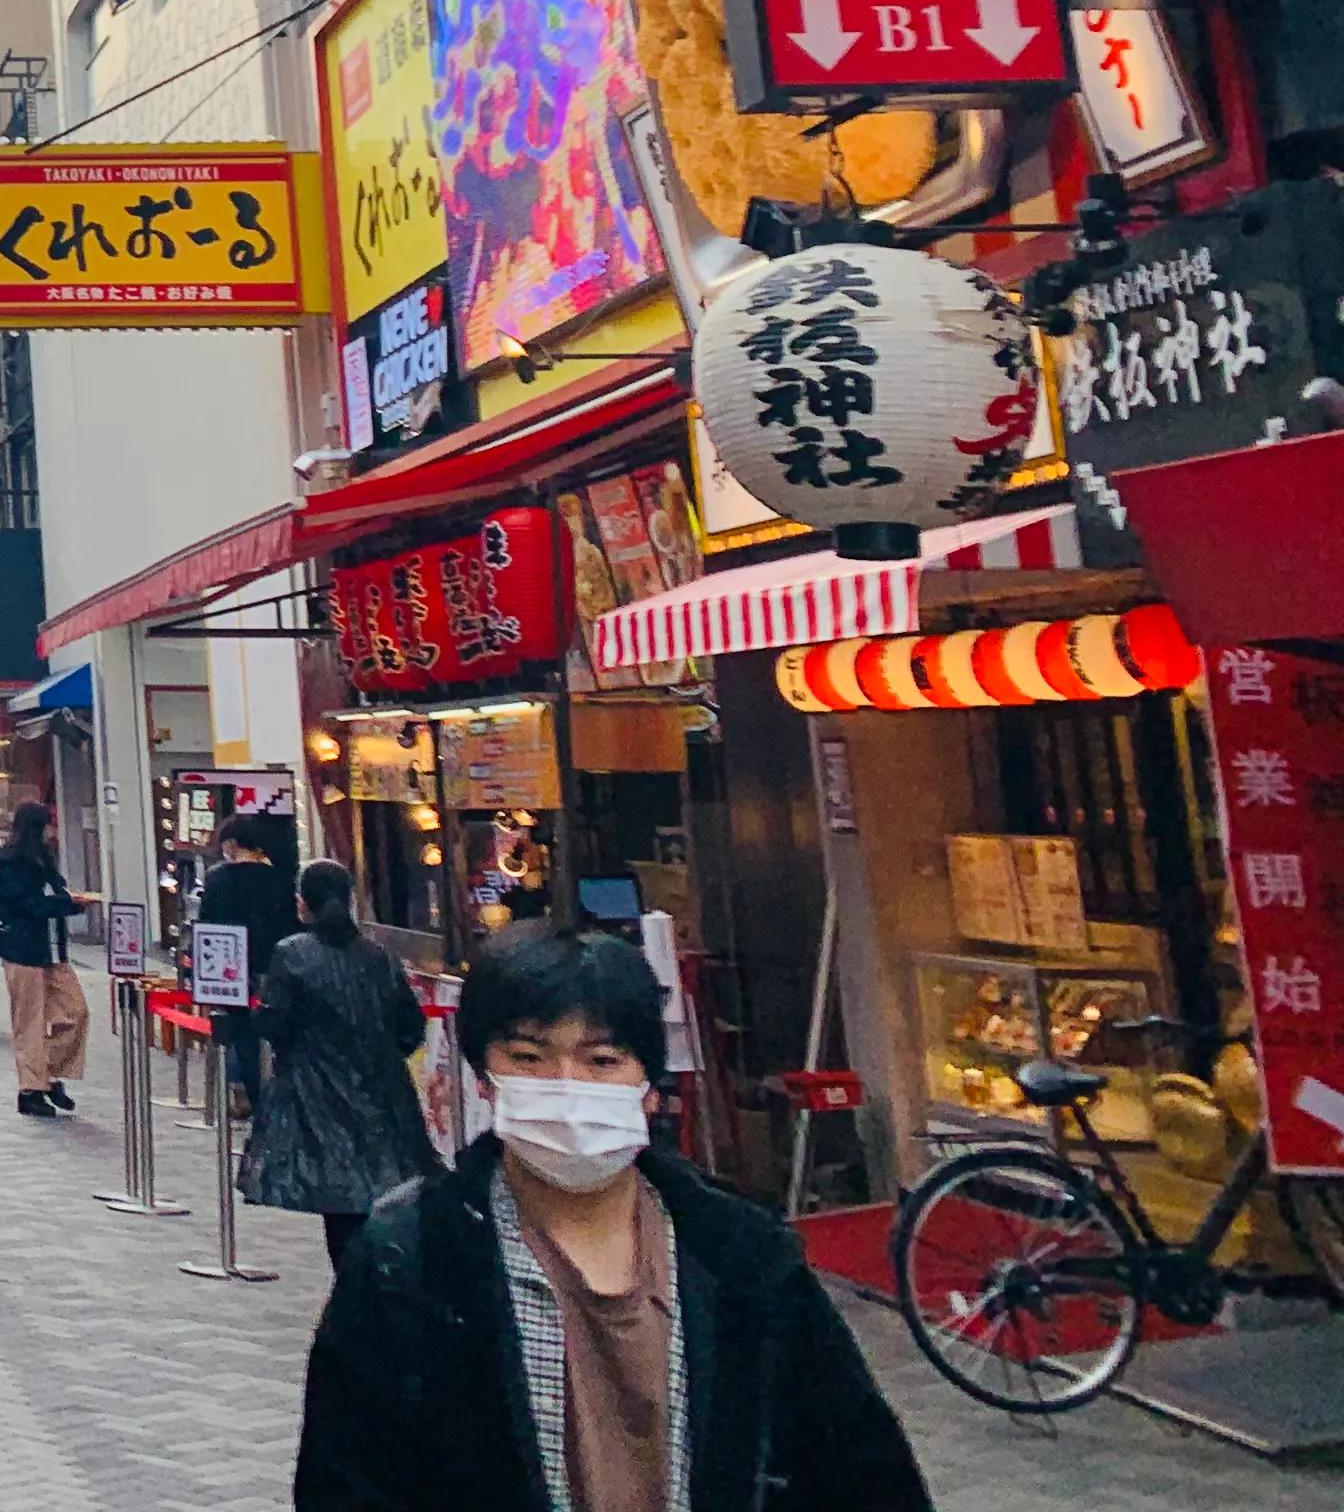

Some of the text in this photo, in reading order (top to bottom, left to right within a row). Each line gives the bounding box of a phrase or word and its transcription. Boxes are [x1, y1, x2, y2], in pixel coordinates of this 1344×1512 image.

[871, 4, 953, 53] B1
[1219, 648, 1321, 1013] 営業開始
